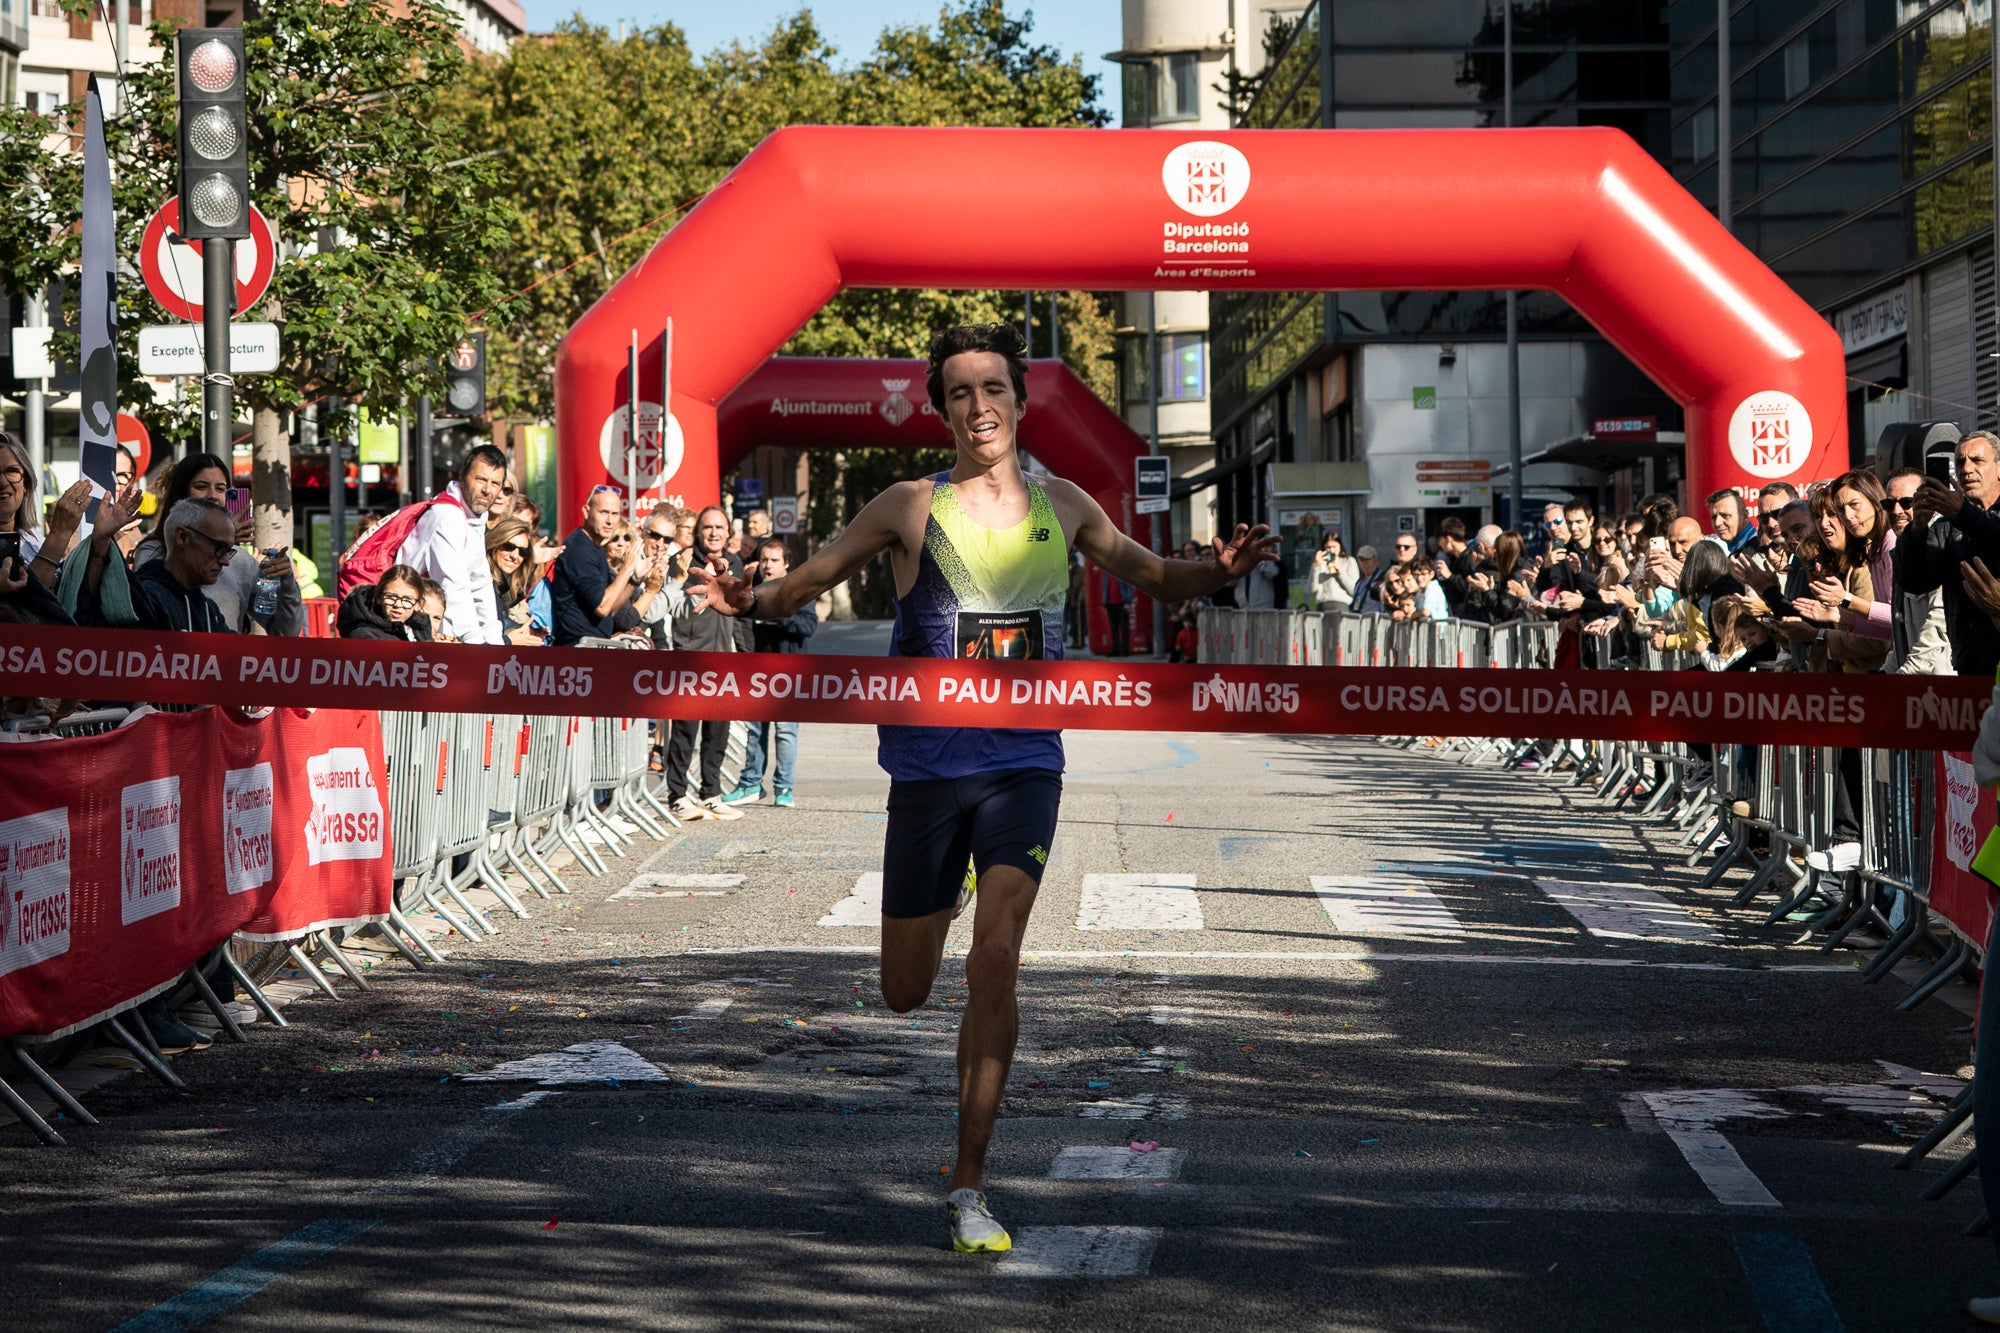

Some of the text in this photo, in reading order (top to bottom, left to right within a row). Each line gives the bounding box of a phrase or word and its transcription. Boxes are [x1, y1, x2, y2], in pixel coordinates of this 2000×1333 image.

[1164, 222, 1250, 239] Diputació
[1164, 239, 1249, 253] Barcelona
[1190, 267, 1256, 278] d'Esports
[152, 345, 195, 357] Excepte
[229, 344, 265, 354] octurn
[770, 398, 873, 416] Ajuntament
[1002, 639, 1010, 657] 1
[0, 646, 46, 675] SA
[55, 645, 222, 681] SOLIDÀRIA
[239, 655, 302, 685] PAU
[310, 655, 449, 689] DINARÈS
[633, 669, 741, 698] CURSA
[749, 668, 921, 701] SOLIDÀRIA
[938, 677, 1001, 704] PAU
[1010, 674, 1152, 707] DINARÈS
[1340, 684, 1450, 712] CURSA
[1458, 681, 1633, 716] SOLIDÀRIA
[1650, 690, 1712, 718] PAU
[1723, 687, 1866, 723] DINARÈS
[136, 795, 178, 839] Ajuntament de
[14, 829, 67, 880] Ajuntament de
[137, 848, 178, 898] Terrassa
[14, 890, 67, 946] Terrassa
